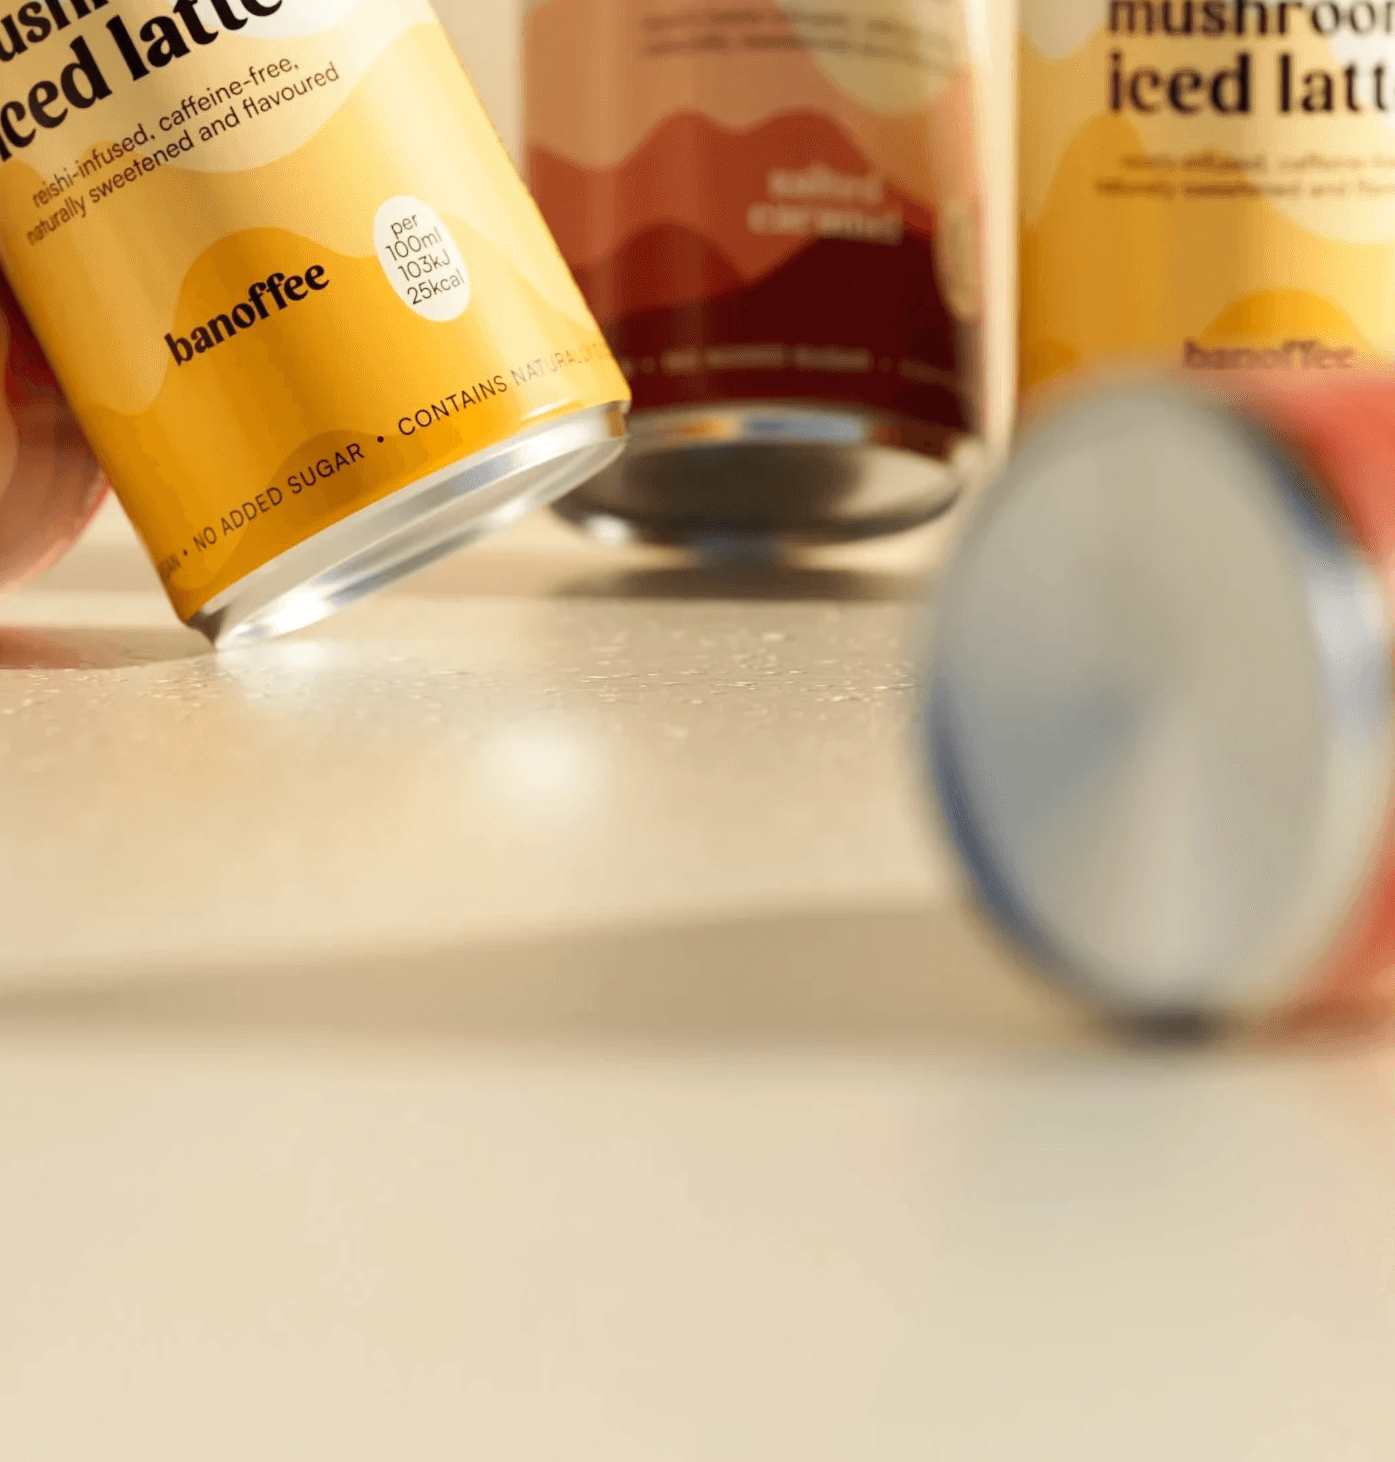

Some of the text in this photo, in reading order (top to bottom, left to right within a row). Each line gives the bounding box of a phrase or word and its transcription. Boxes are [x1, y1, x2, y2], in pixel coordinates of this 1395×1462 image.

[1109, 48, 1395, 116] iced latt
[26, 61, 341, 247] naturally sweetened and flavoured
[32, 56, 300, 209] reishi-infused, caffeine-free,
[385, 226, 443, 261] 100ml
[390, 212, 419, 240] per
[398, 249, 451, 282] 103kJ
[406, 269, 465, 305] 25kcal
[163, 263, 330, 367] banoffee
[193, 526, 217, 552] NO
[220, 486, 283, 536] ADDED
[287, 440, 365, 494] SUGAR
[397, 374, 507, 436] CONTAINS
[510, 341, 600, 386] NATURAL
